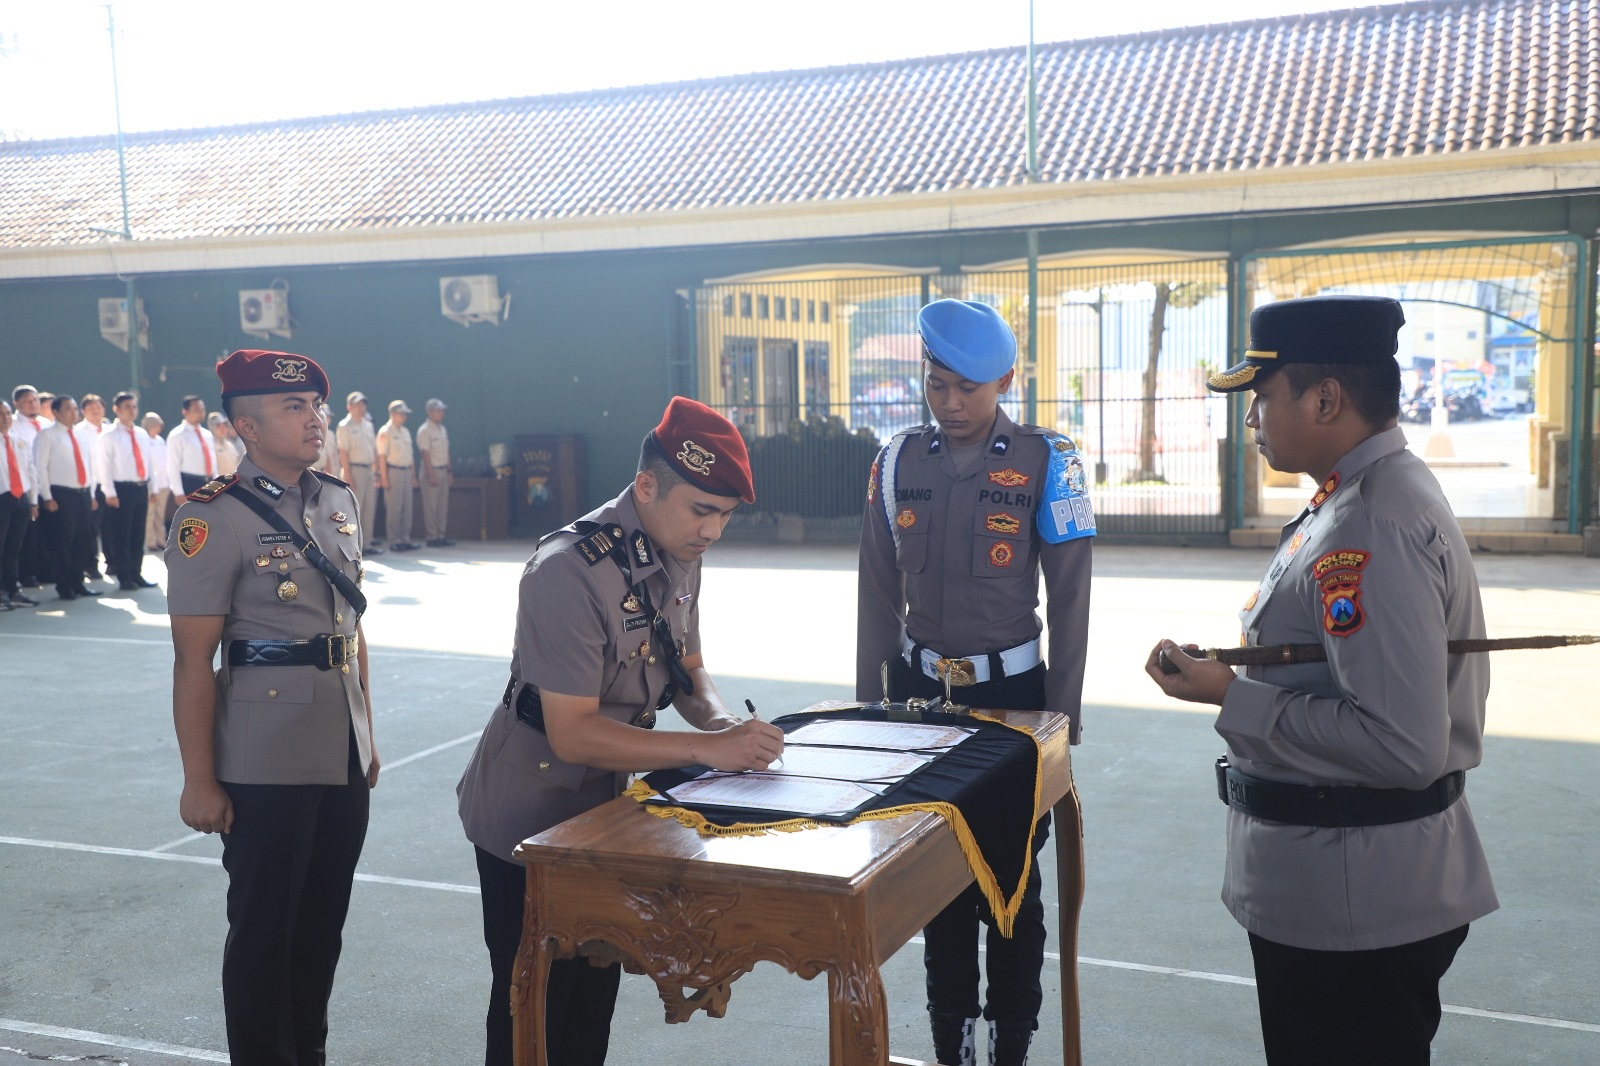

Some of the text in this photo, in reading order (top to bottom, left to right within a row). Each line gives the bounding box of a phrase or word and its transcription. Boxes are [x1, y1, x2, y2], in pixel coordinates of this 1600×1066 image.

[979, 489, 1032, 508] POLRI
[1316, 552, 1364, 571] POLRES
[1323, 574, 1358, 588] JAWA TIMUR
